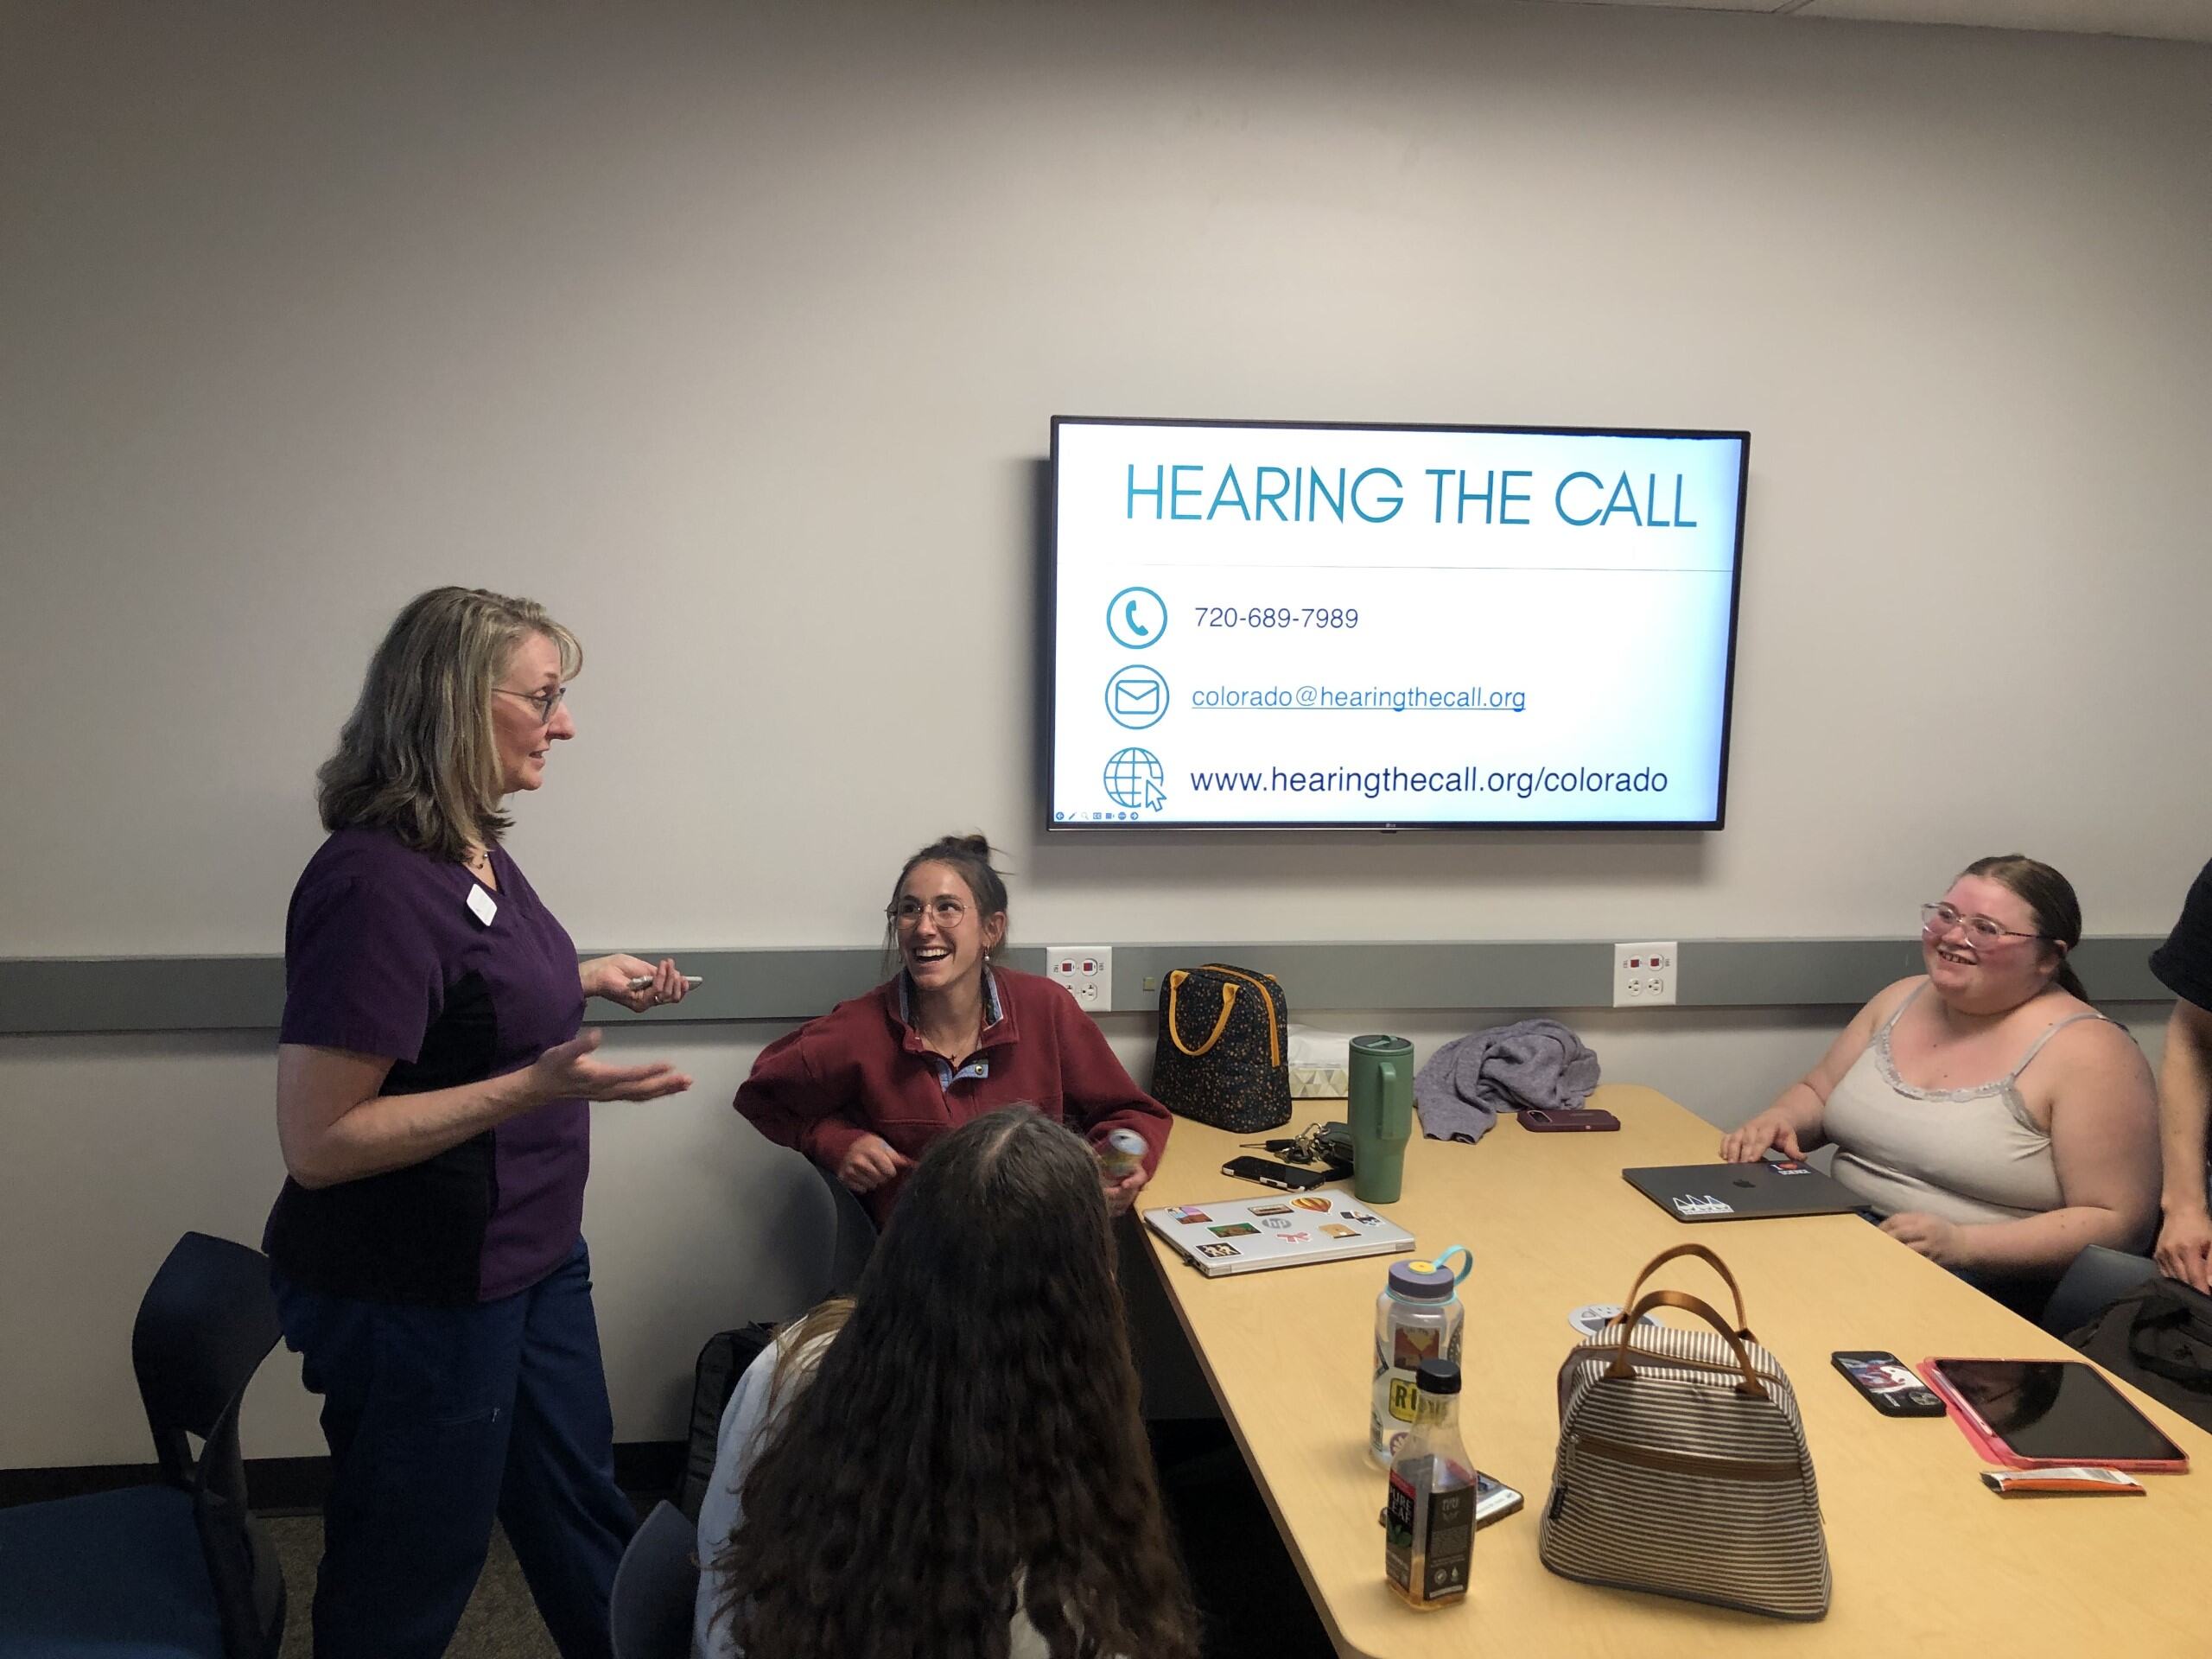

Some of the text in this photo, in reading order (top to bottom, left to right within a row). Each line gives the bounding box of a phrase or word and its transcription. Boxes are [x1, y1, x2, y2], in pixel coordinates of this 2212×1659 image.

[1127, 463, 1698, 528] HEARING THE CALL
[1194, 607, 1359, 629] 720-689-7989
[1192, 684, 1527, 712] colorado@hearingthecall.org
[1190, 766, 1669, 799] www.hearingthecall.org/colorado
